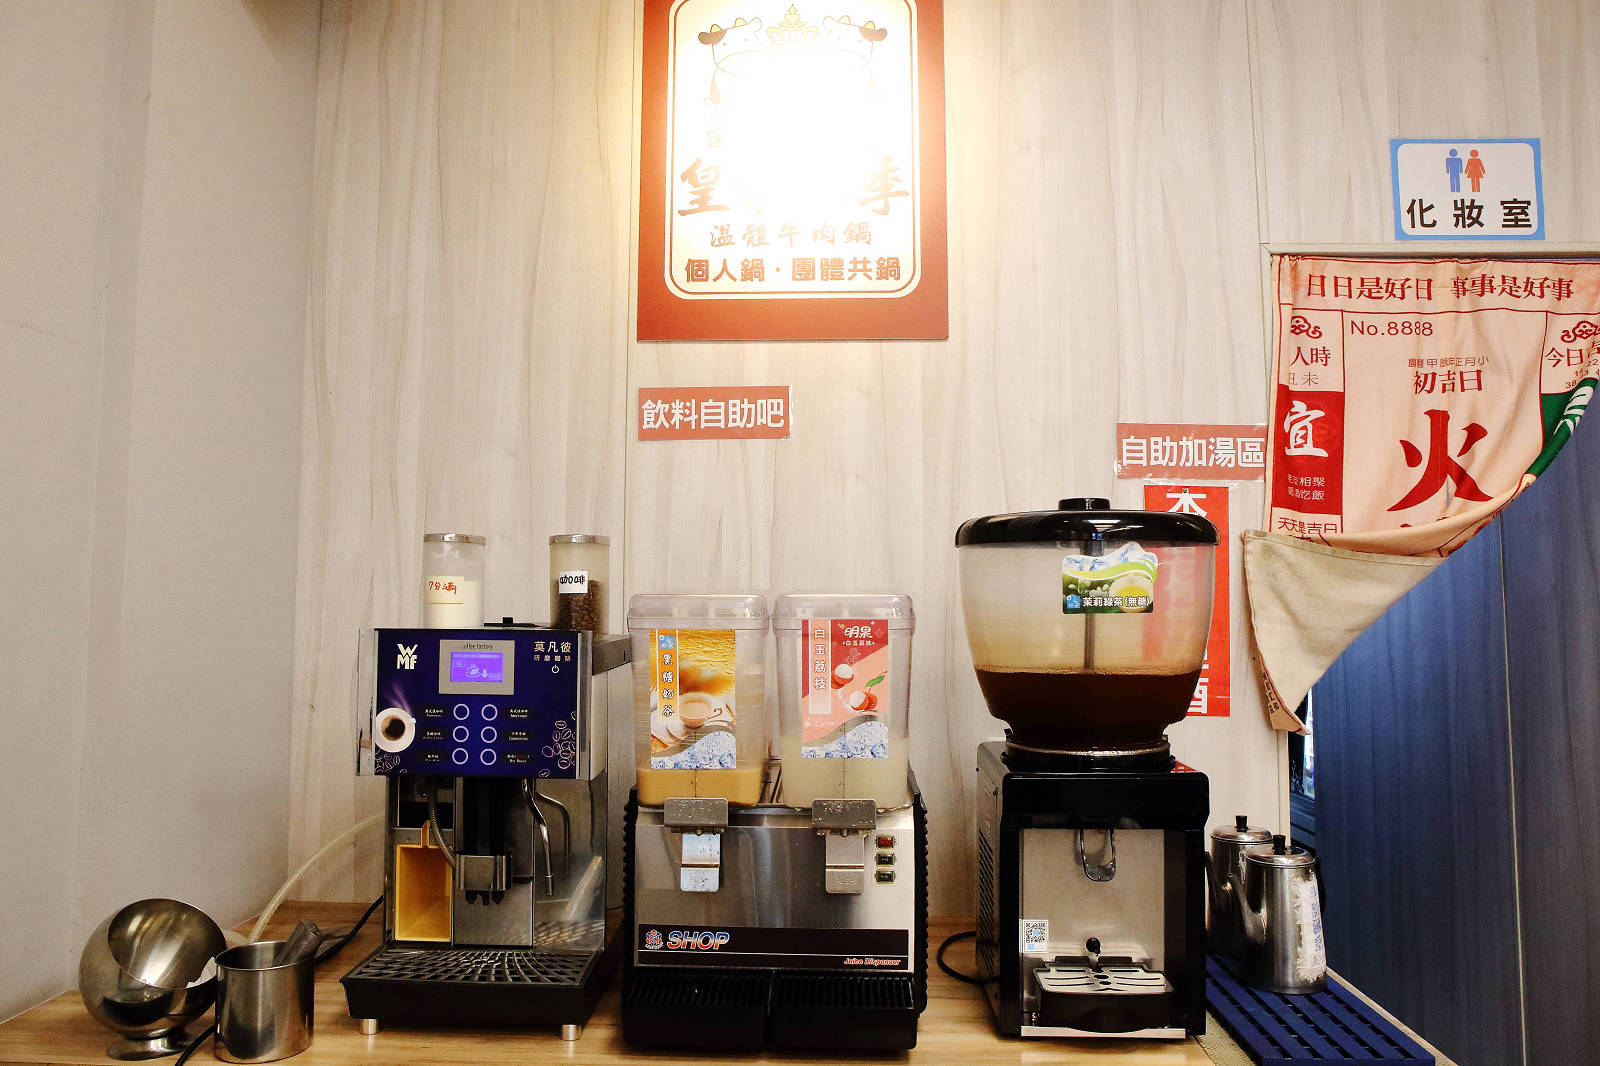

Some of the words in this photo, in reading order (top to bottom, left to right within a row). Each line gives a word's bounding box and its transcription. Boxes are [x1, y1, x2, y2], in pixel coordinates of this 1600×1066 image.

[1406, 198, 1532, 229] 化妝室
[1307, 273, 1433, 301] 日日是好日
[1350, 320, 1434, 337] No.8888
[641, 397, 785, 430] 飲料自助吧
[1283, 400, 1329, 458] 宜
[1122, 434, 1265, 468] 自助加湯區
[1386, 408, 1494, 512] 火
[533, 641, 572, 653] 莫凡彼
[814, 627, 827, 691] 白玉荔枝
[666, 930, 730, 950] SHOP
